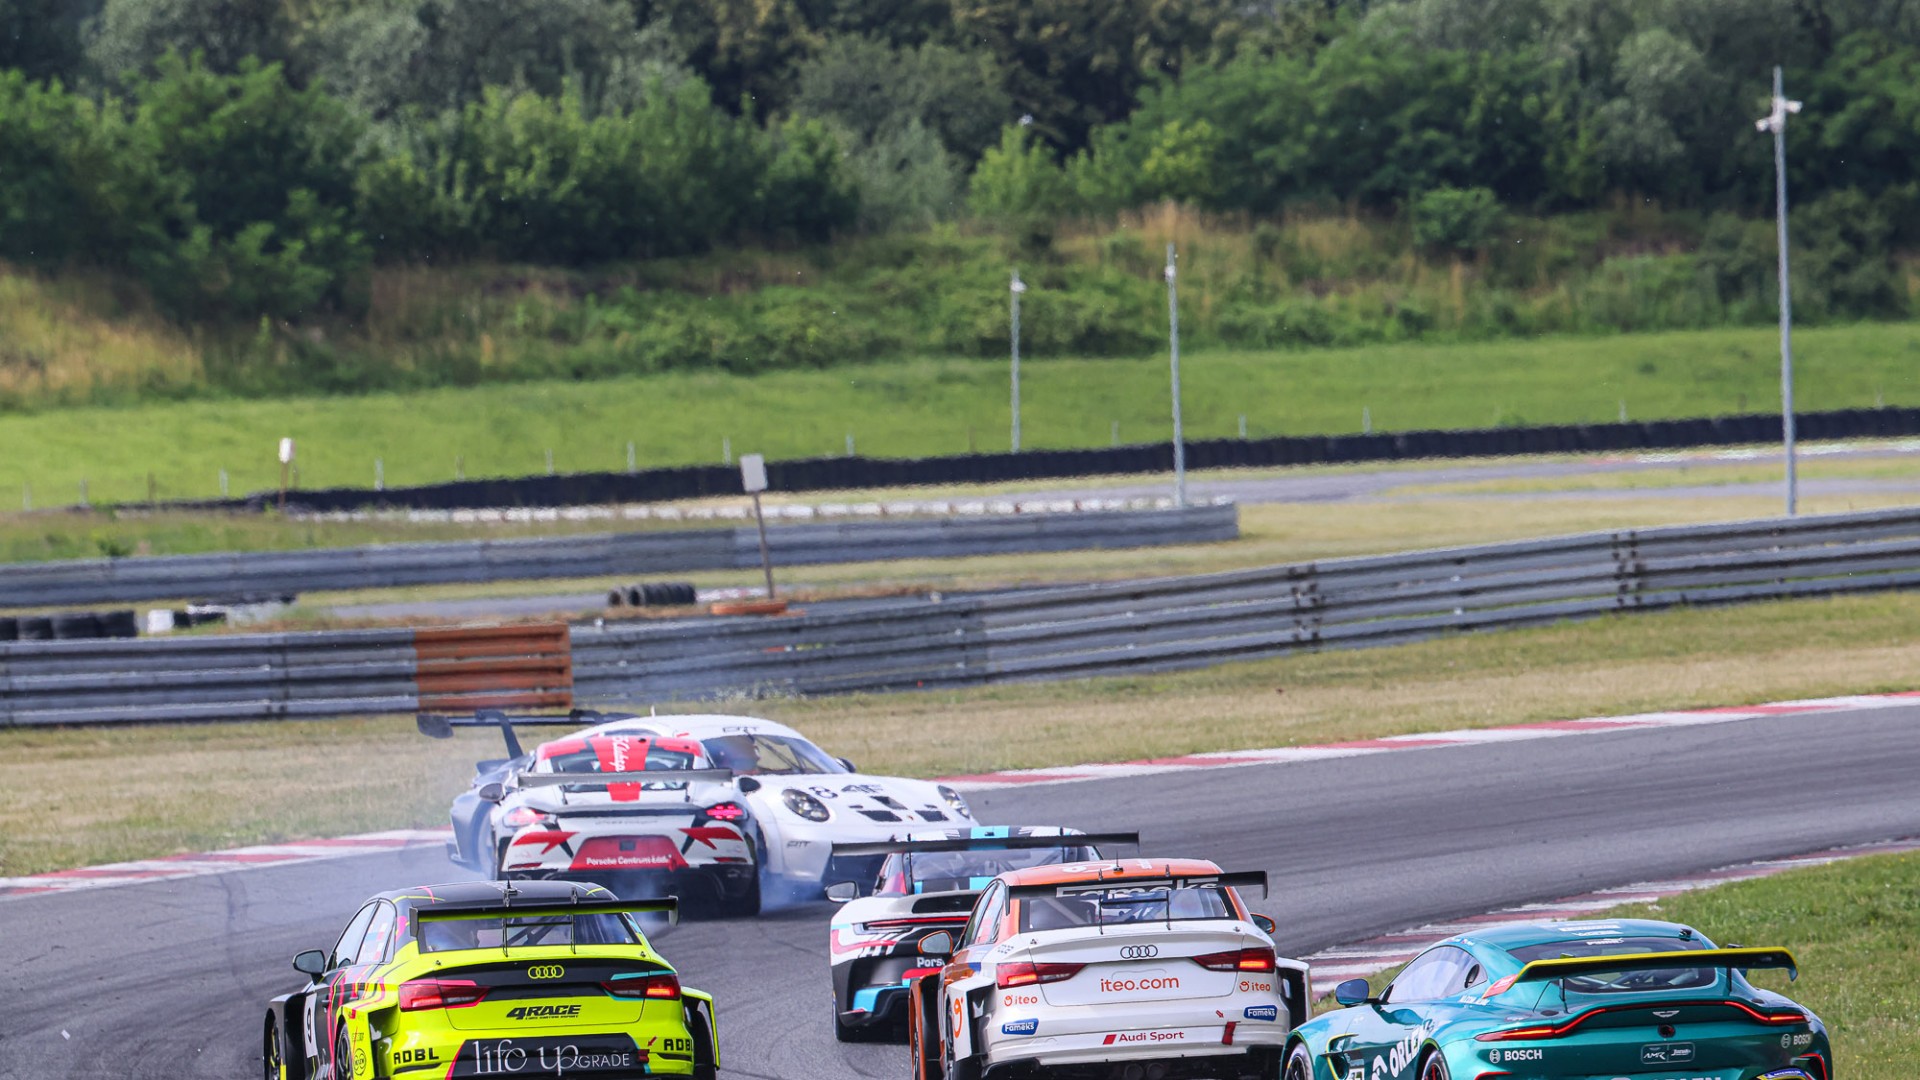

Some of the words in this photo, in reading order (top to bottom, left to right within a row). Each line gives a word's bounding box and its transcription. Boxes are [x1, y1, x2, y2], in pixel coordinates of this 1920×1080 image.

[586, 857, 617, 866] Porsche
[917, 956, 946, 968] Pors
[1101, 977, 1180, 993] iteo.com
[1252, 982, 1271, 992] iteo
[1014, 995, 1038, 1005] iteo
[506, 1004, 582, 1020] 4RACE
[1247, 1009, 1276, 1017] Fameks
[1004, 1022, 1035, 1032] Fameks
[1118, 1033, 1147, 1043] Audi
[1150, 1031, 1185, 1042] Sport
[393, 1048, 439, 1065] ADBL
[473, 1039, 528, 1075] life
[1504, 1049, 1543, 1061] BOSCH
[1643, 1051, 1666, 1061] AMR
